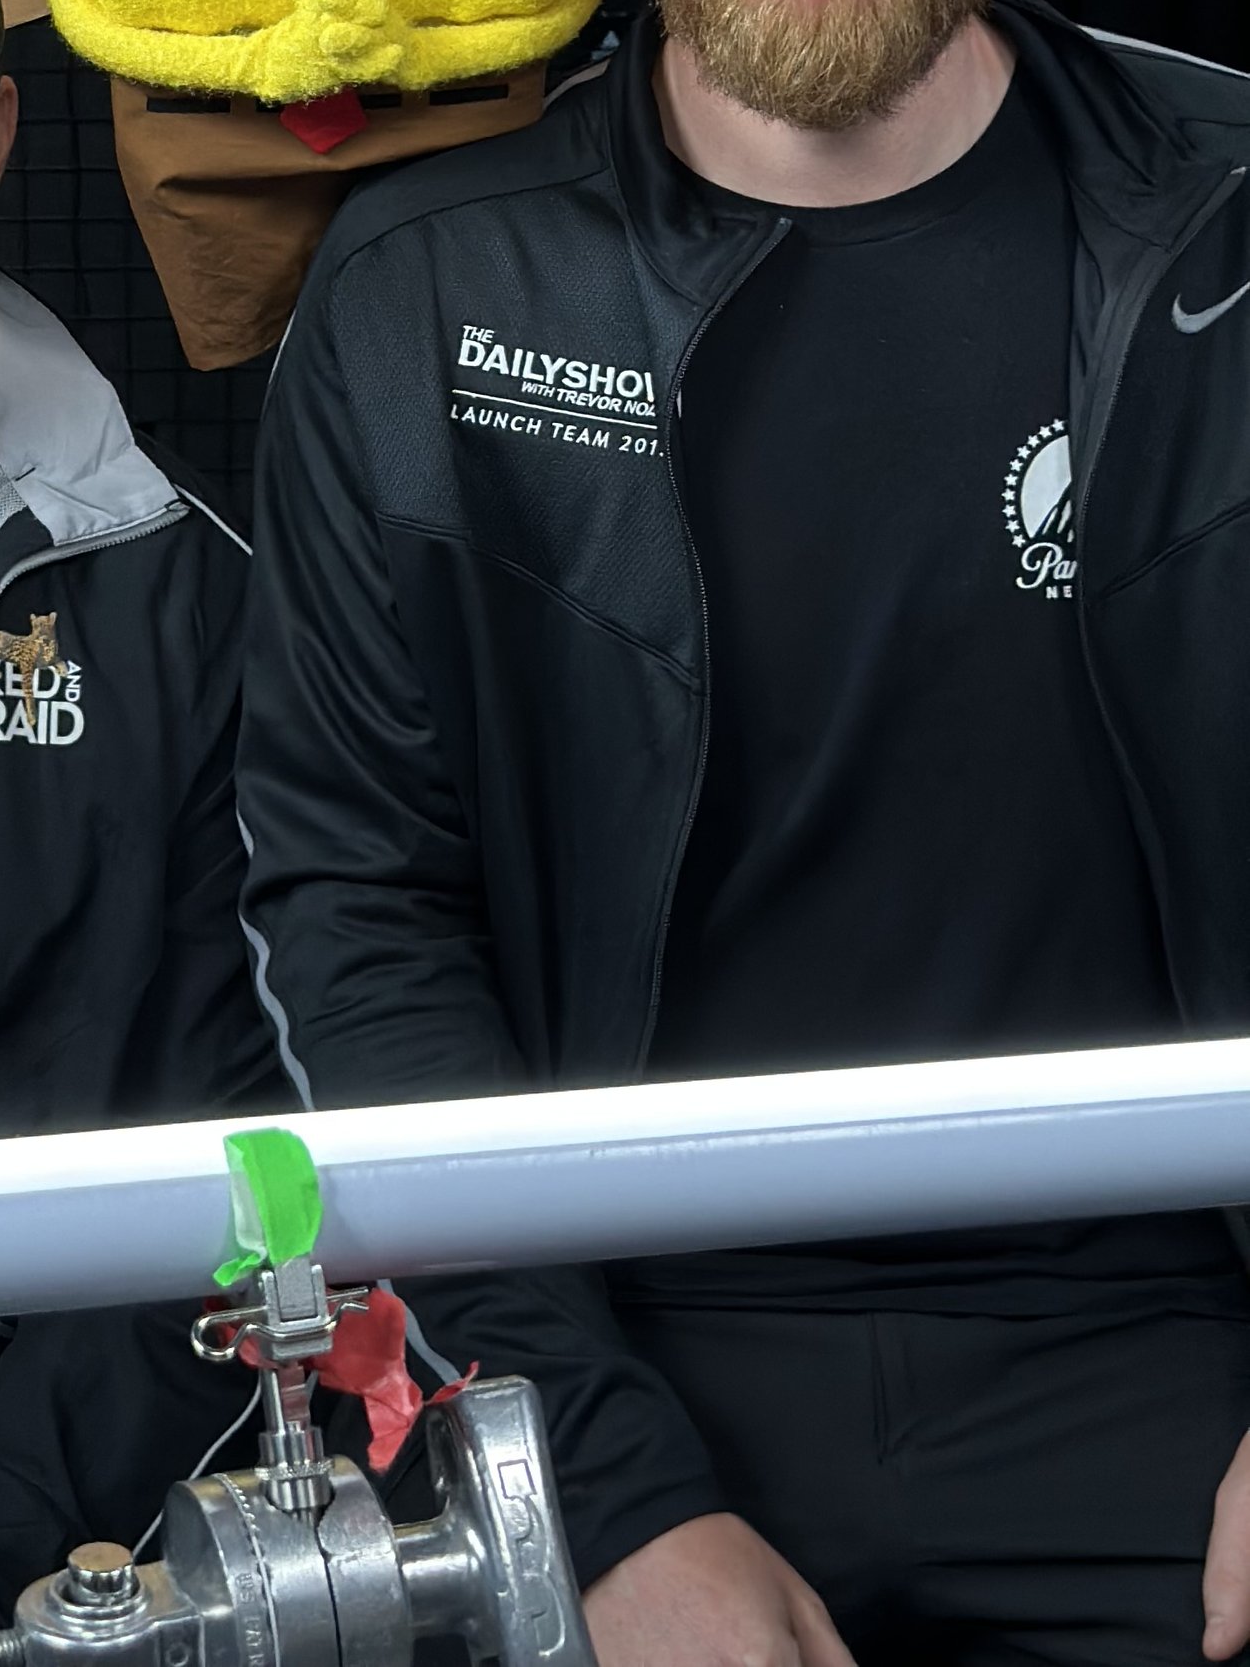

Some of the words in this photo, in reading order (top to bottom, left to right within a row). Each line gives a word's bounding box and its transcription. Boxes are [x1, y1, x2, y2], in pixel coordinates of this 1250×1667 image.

[462, 325, 494, 344] THE
[521, 381, 554, 397] WITH
[556, 389, 622, 411] TREVOR
[450, 404, 542, 435] LAUNCH
[552, 422, 610, 449] TEAM
[619, 435, 664, 457] 201
[65, 660, 82, 702] AND
